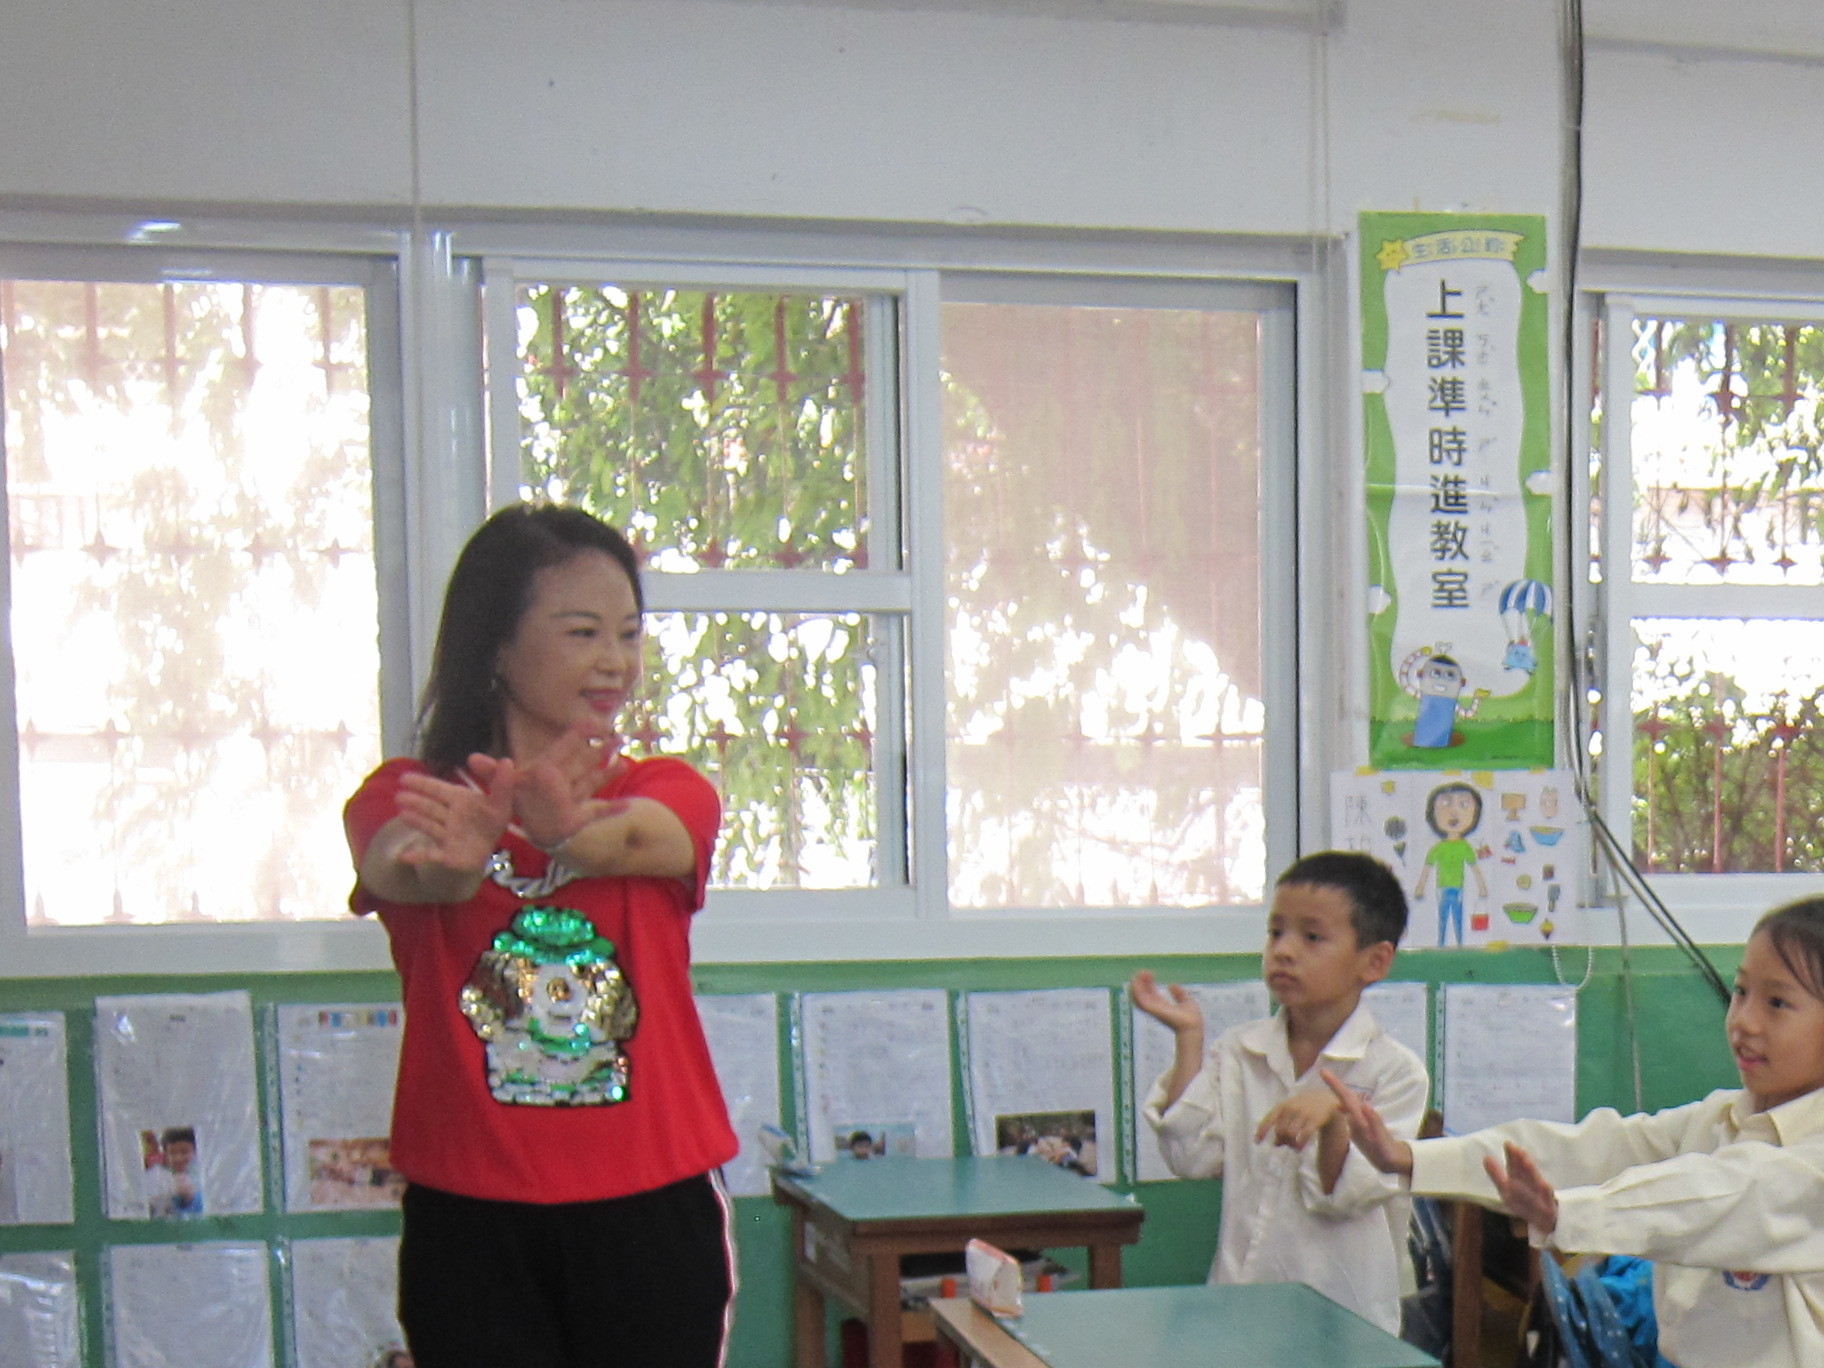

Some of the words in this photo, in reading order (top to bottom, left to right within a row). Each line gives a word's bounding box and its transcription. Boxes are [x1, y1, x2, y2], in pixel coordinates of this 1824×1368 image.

[1426, 278, 1470, 609] 上課準時進教室
